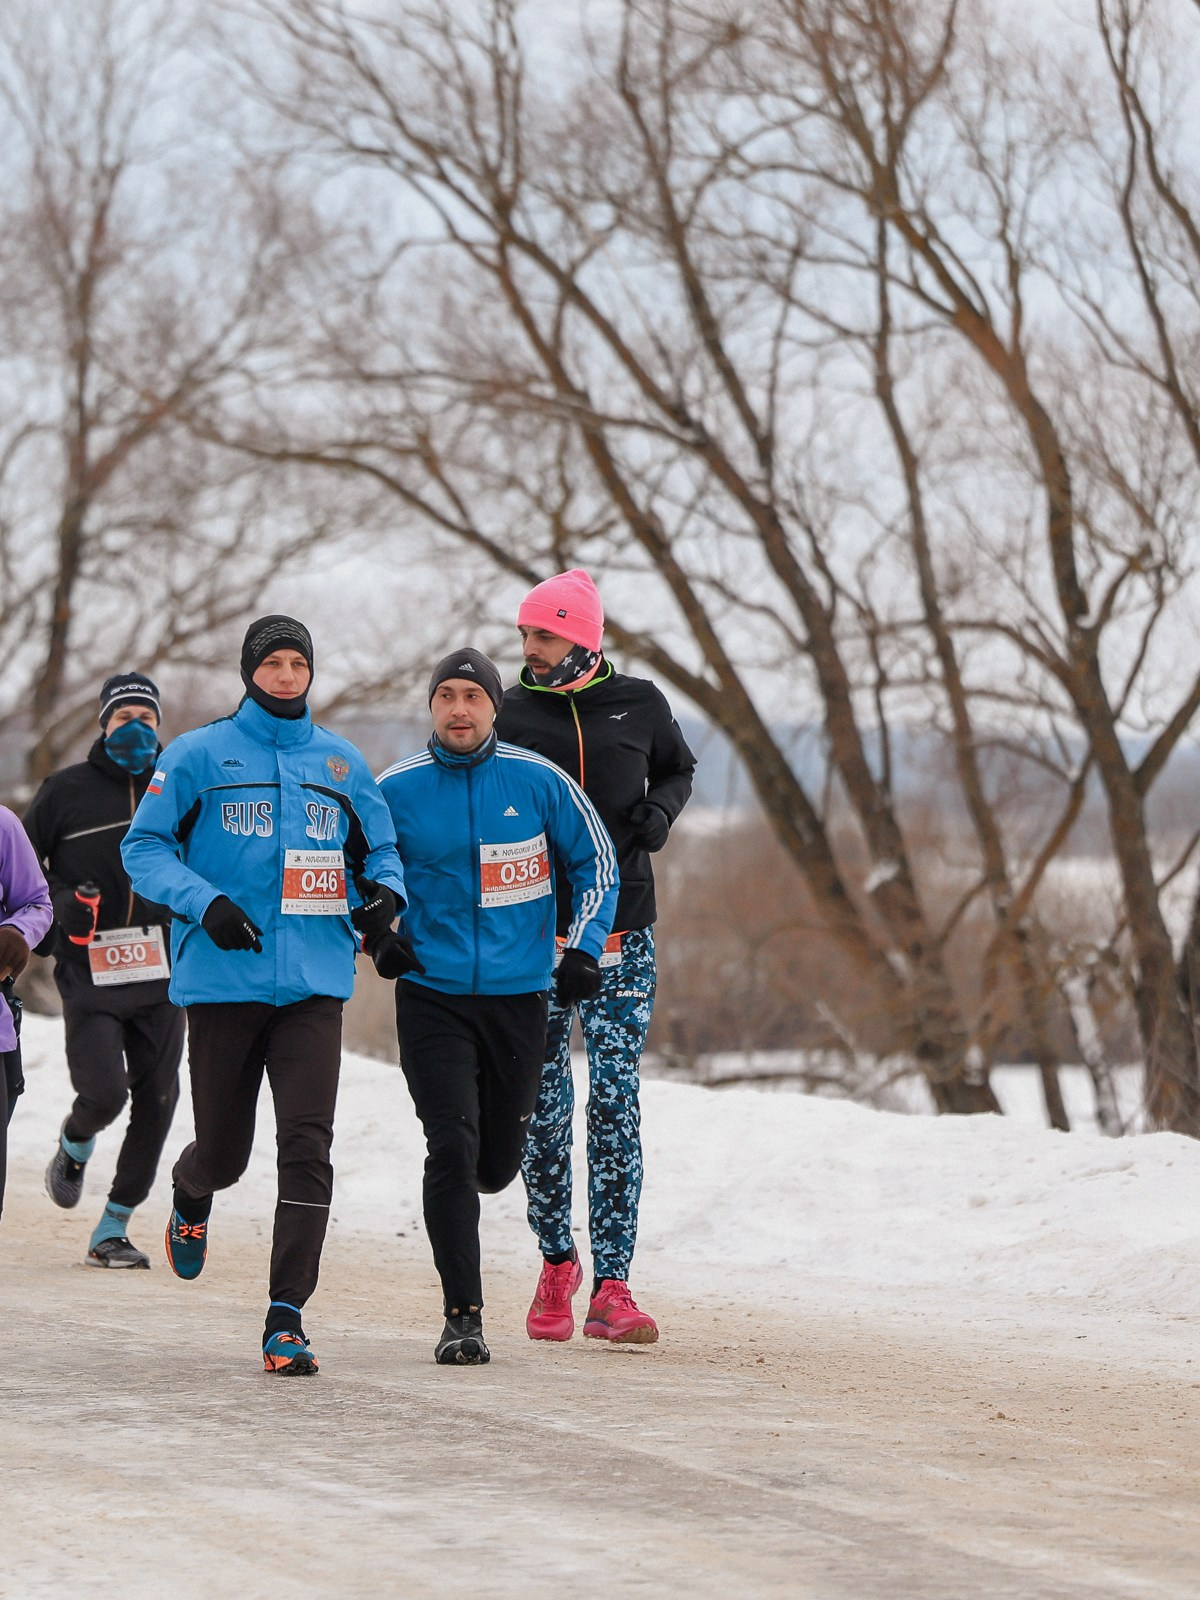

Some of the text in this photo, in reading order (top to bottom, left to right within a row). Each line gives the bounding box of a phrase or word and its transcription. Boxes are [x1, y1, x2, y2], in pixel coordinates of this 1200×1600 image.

[221, 801, 273, 837] RUS
[301, 870, 338, 892] 046
[500, 857, 540, 884] 036
[105, 943, 147, 965] 030
[615, 990, 648, 999] SAYSKY
